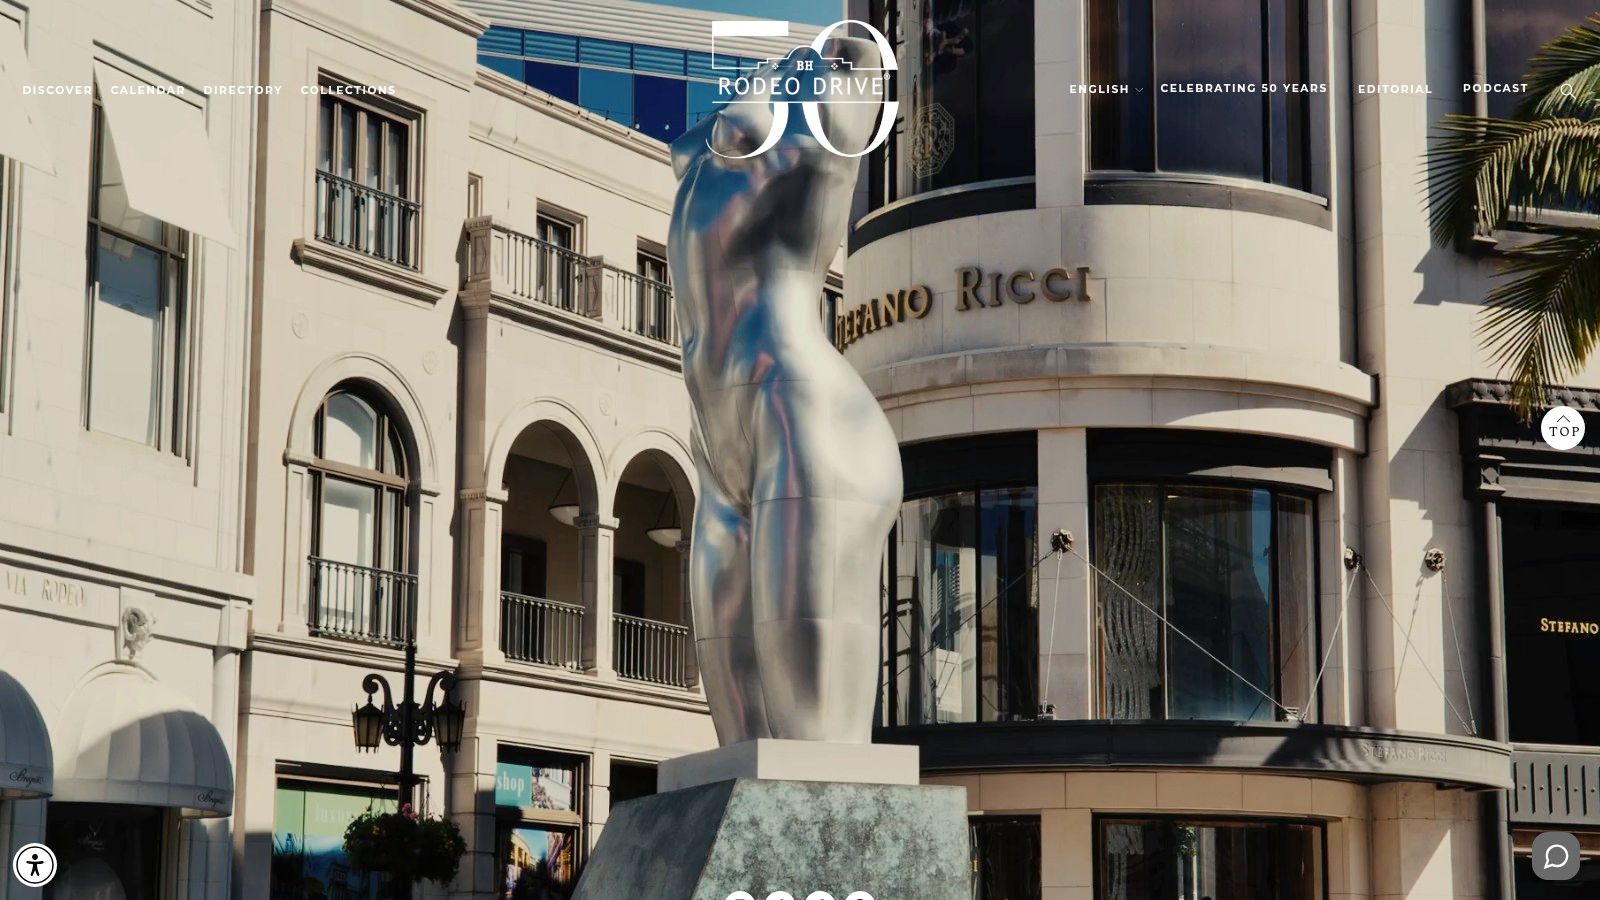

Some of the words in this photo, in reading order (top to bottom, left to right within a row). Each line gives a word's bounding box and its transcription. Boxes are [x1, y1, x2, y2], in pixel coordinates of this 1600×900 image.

[954, 266, 1092, 311] RICCI
[1540, 617, 1599, 635] STEFANO
[497, 771, 525, 797] shop
